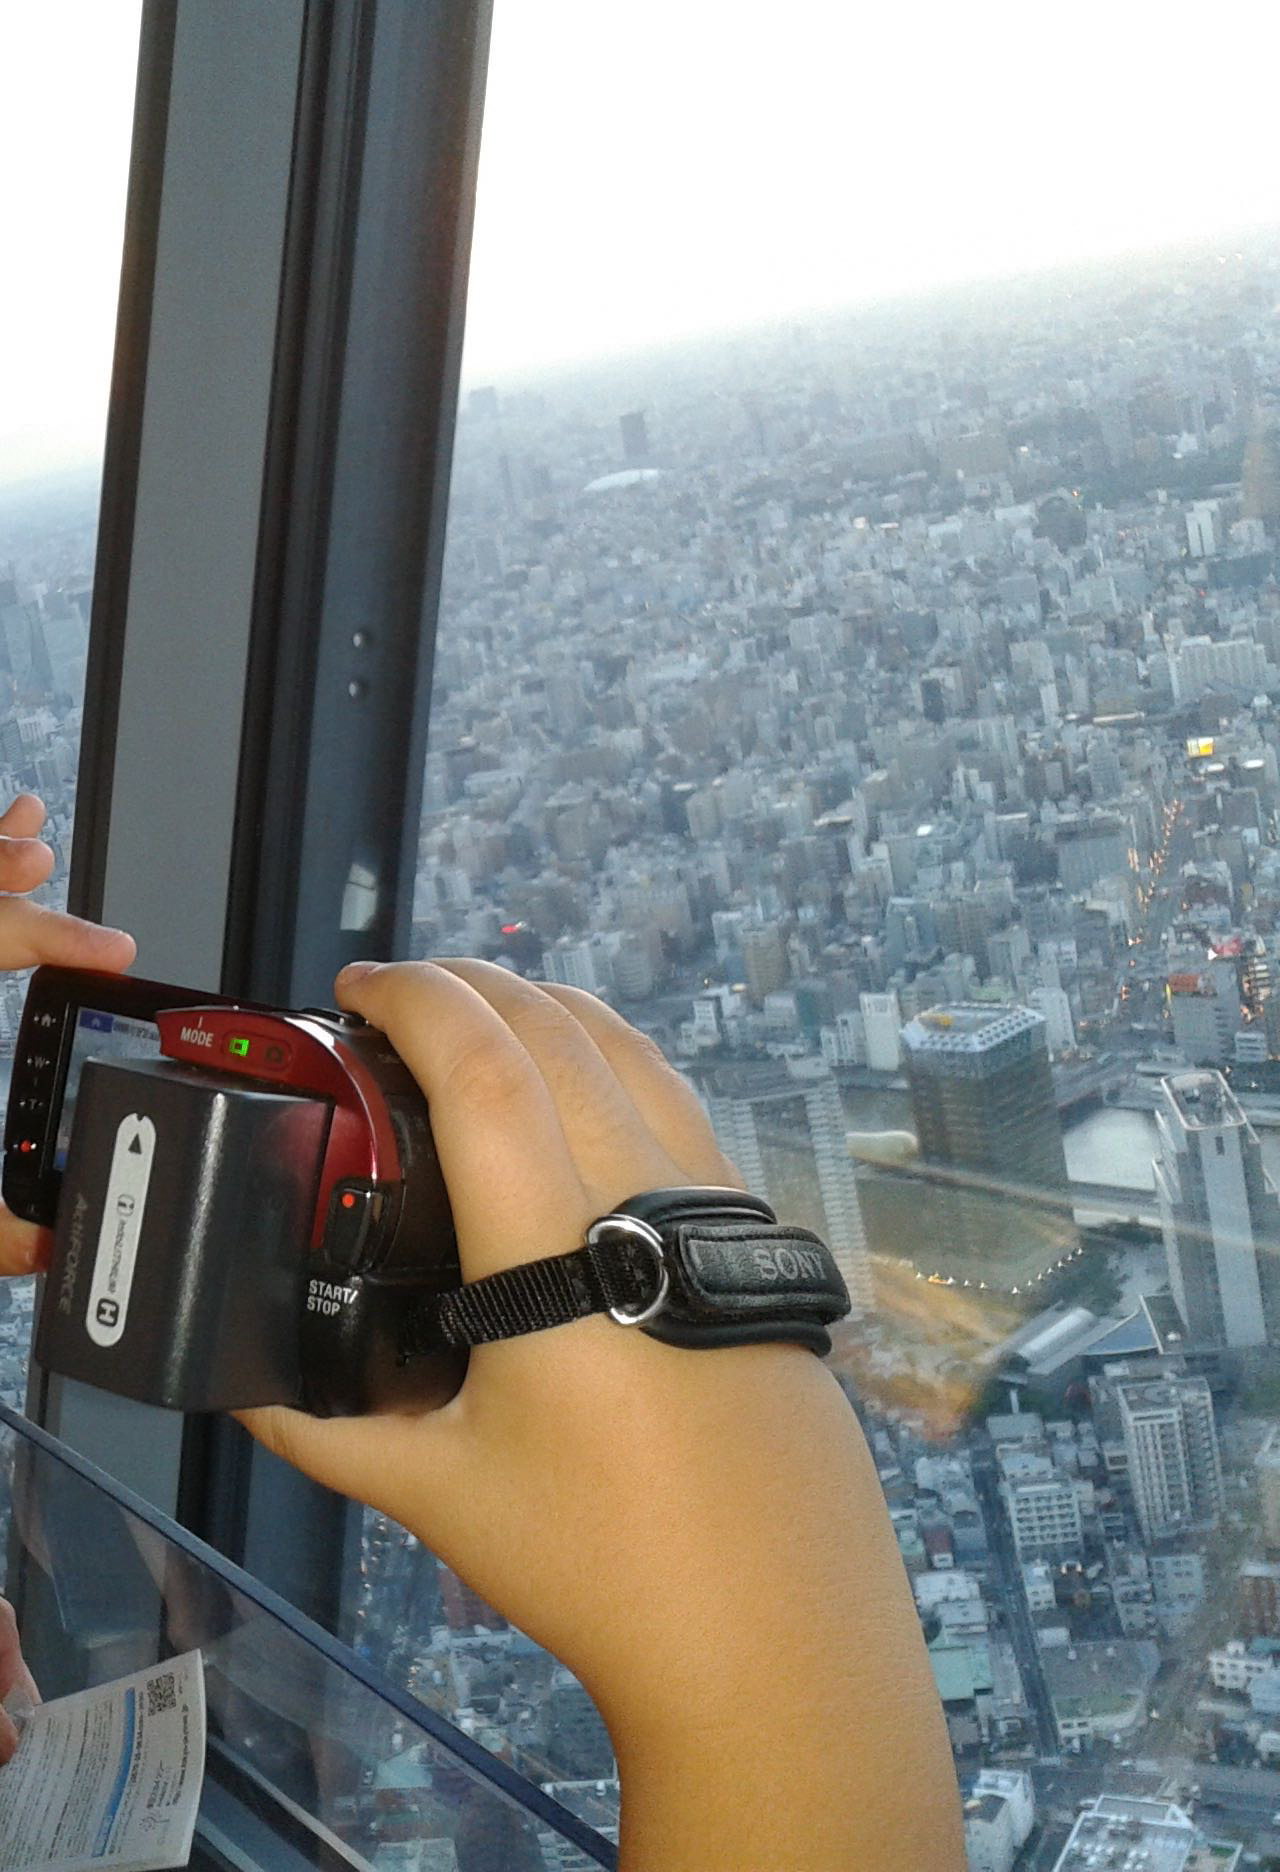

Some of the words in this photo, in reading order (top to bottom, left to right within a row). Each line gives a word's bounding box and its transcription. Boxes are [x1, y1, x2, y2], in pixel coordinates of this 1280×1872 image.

[180, 1026, 214, 1048] MODE
[753, 1247, 827, 1281] SONY
[308, 1279, 359, 1305] START/
[306, 1295, 341, 1317] STOP
